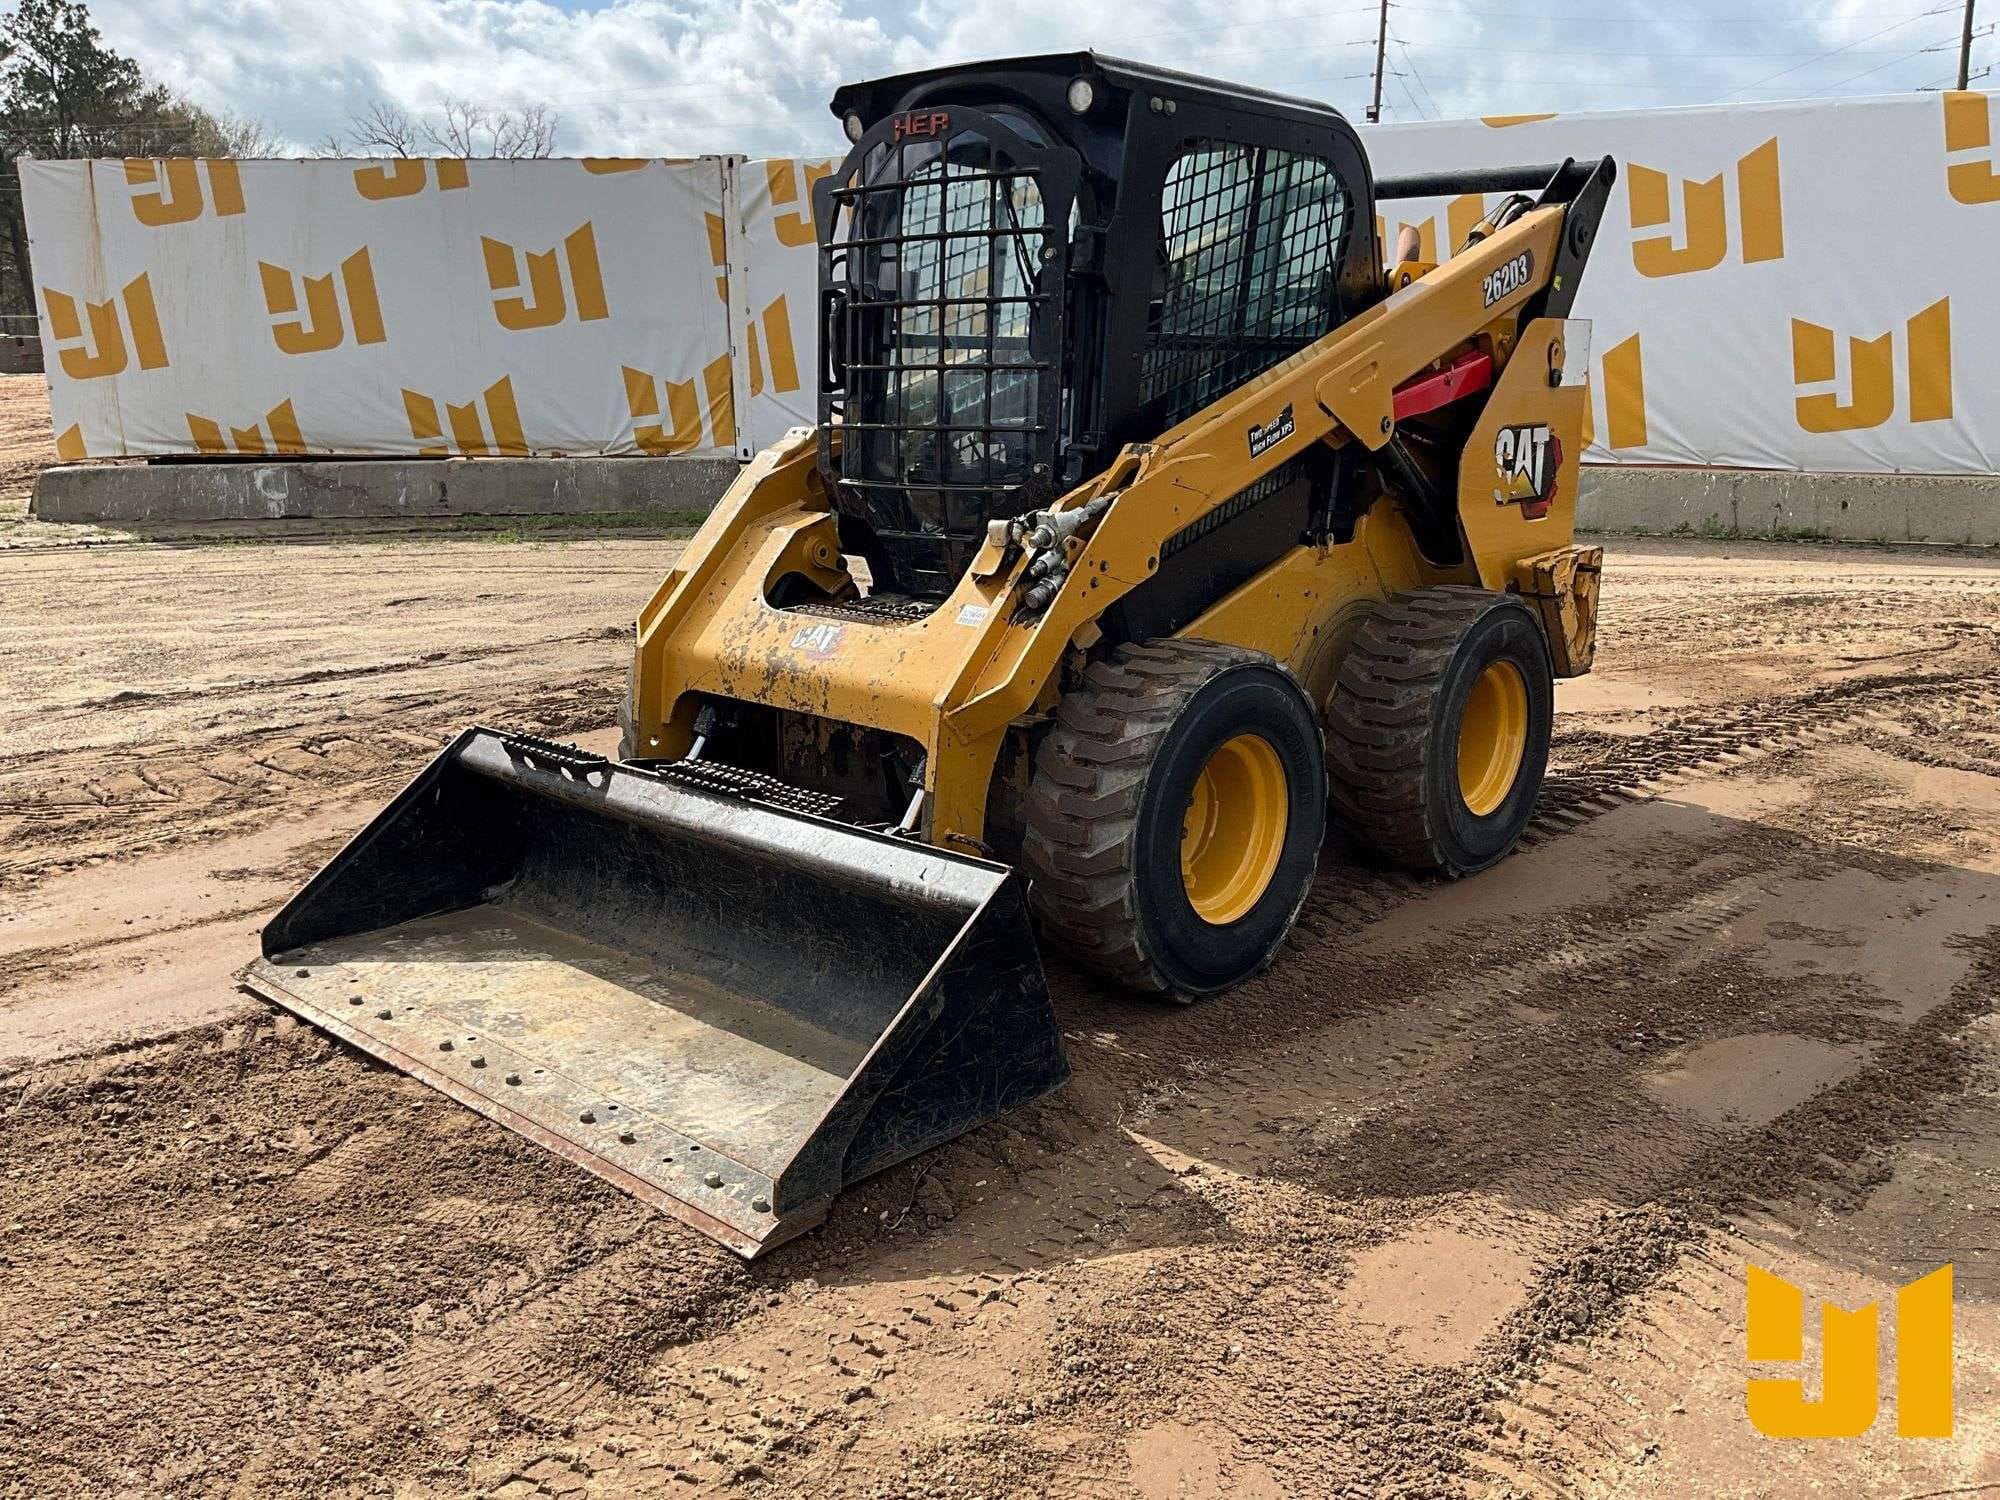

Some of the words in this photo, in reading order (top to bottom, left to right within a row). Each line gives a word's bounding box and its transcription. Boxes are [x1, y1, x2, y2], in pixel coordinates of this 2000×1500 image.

[894, 112, 949, 141] HEP
[1483, 254, 1528, 307] 262D3
[1495, 428, 1550, 501] CAT
[790, 624, 840, 653] CAT
